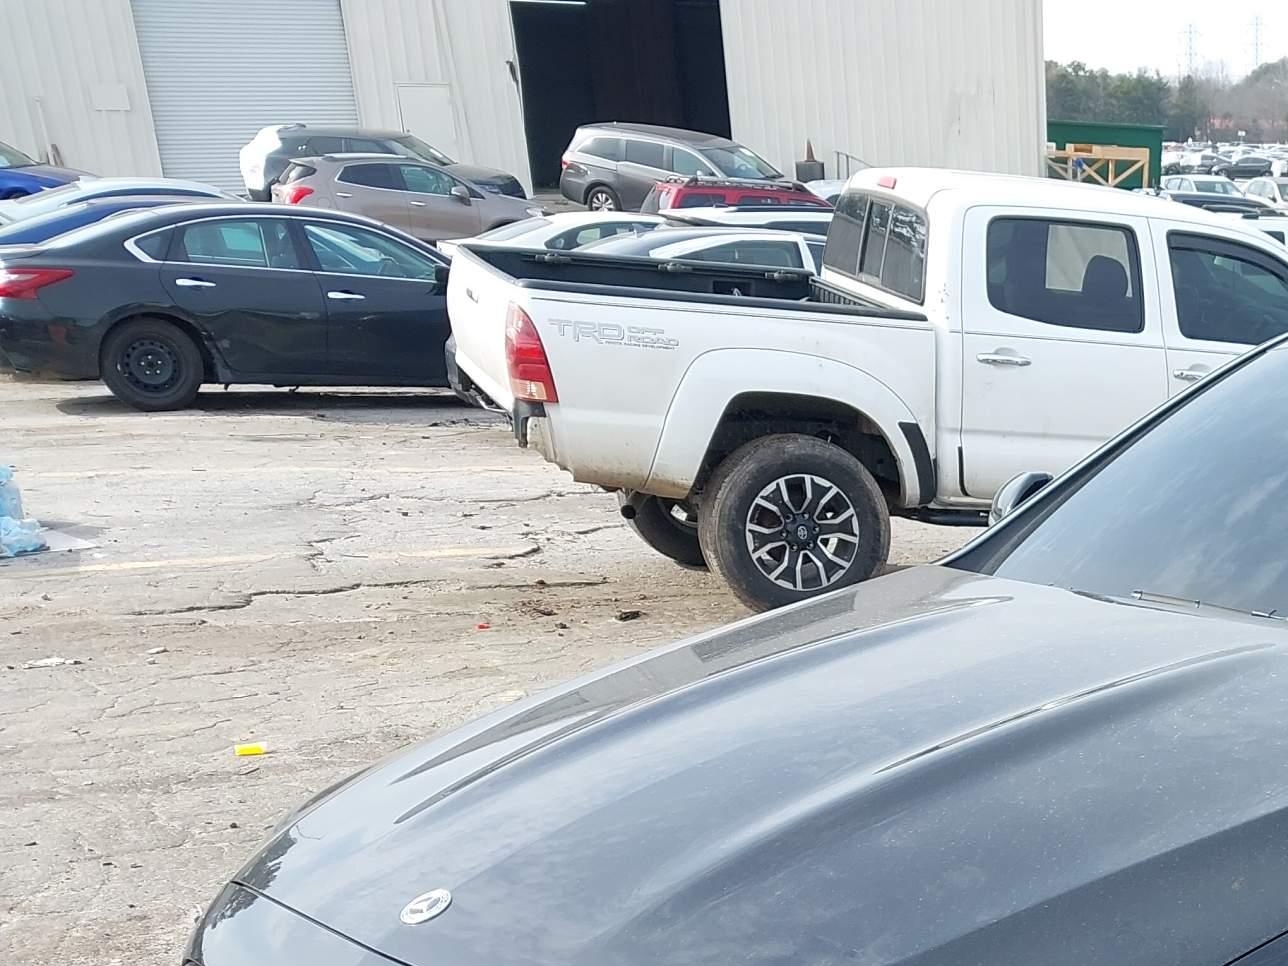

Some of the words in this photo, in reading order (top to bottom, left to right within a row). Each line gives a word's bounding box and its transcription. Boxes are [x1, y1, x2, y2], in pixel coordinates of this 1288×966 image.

[548, 318, 625, 345] TRD
[627, 326, 665, 335] OFF
[627, 335, 680, 347] ROAD
